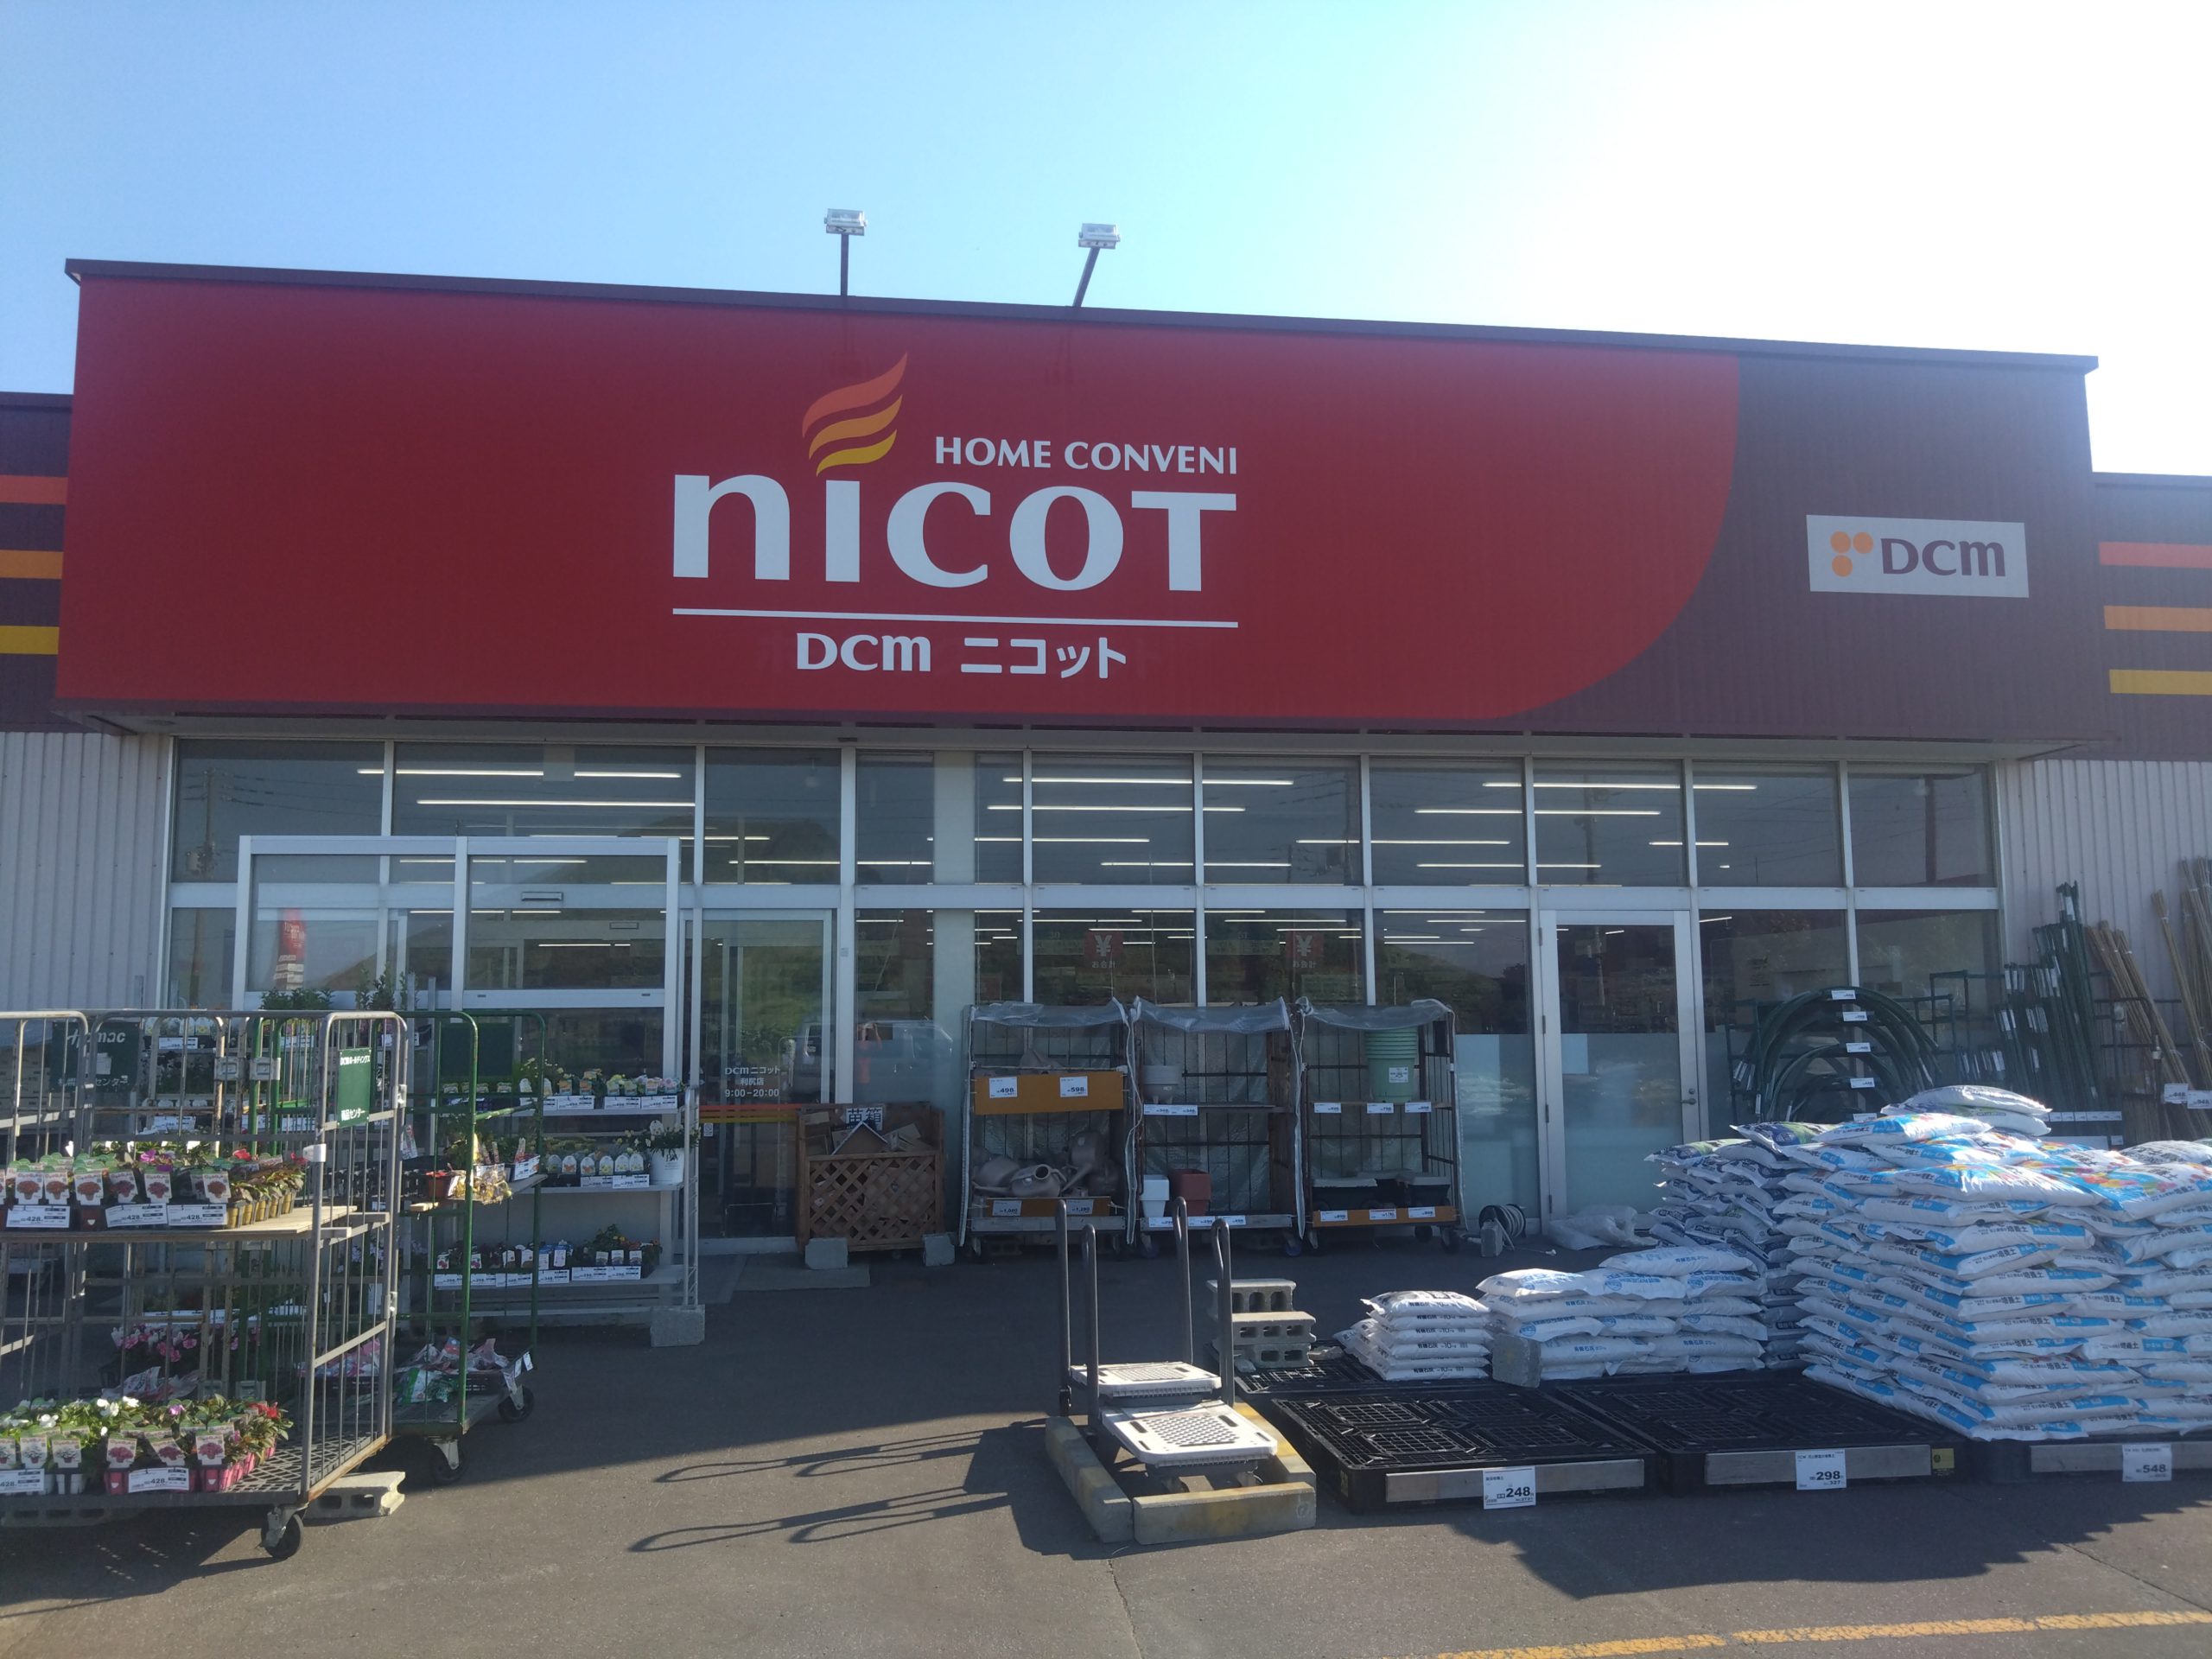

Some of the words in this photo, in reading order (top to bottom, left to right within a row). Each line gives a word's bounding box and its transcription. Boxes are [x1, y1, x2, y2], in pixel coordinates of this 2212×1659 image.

[935, 435, 1052, 468] HOME
[1064, 440, 1237, 475] CONVENI
[960, 636, 1127, 679] ニコット
[750, 1065, 780, 1075] ニコット
[2143, 1464, 2166, 1473] 548
[1815, 1471, 1840, 1480] 298
[1505, 1486, 1530, 1497] 248
